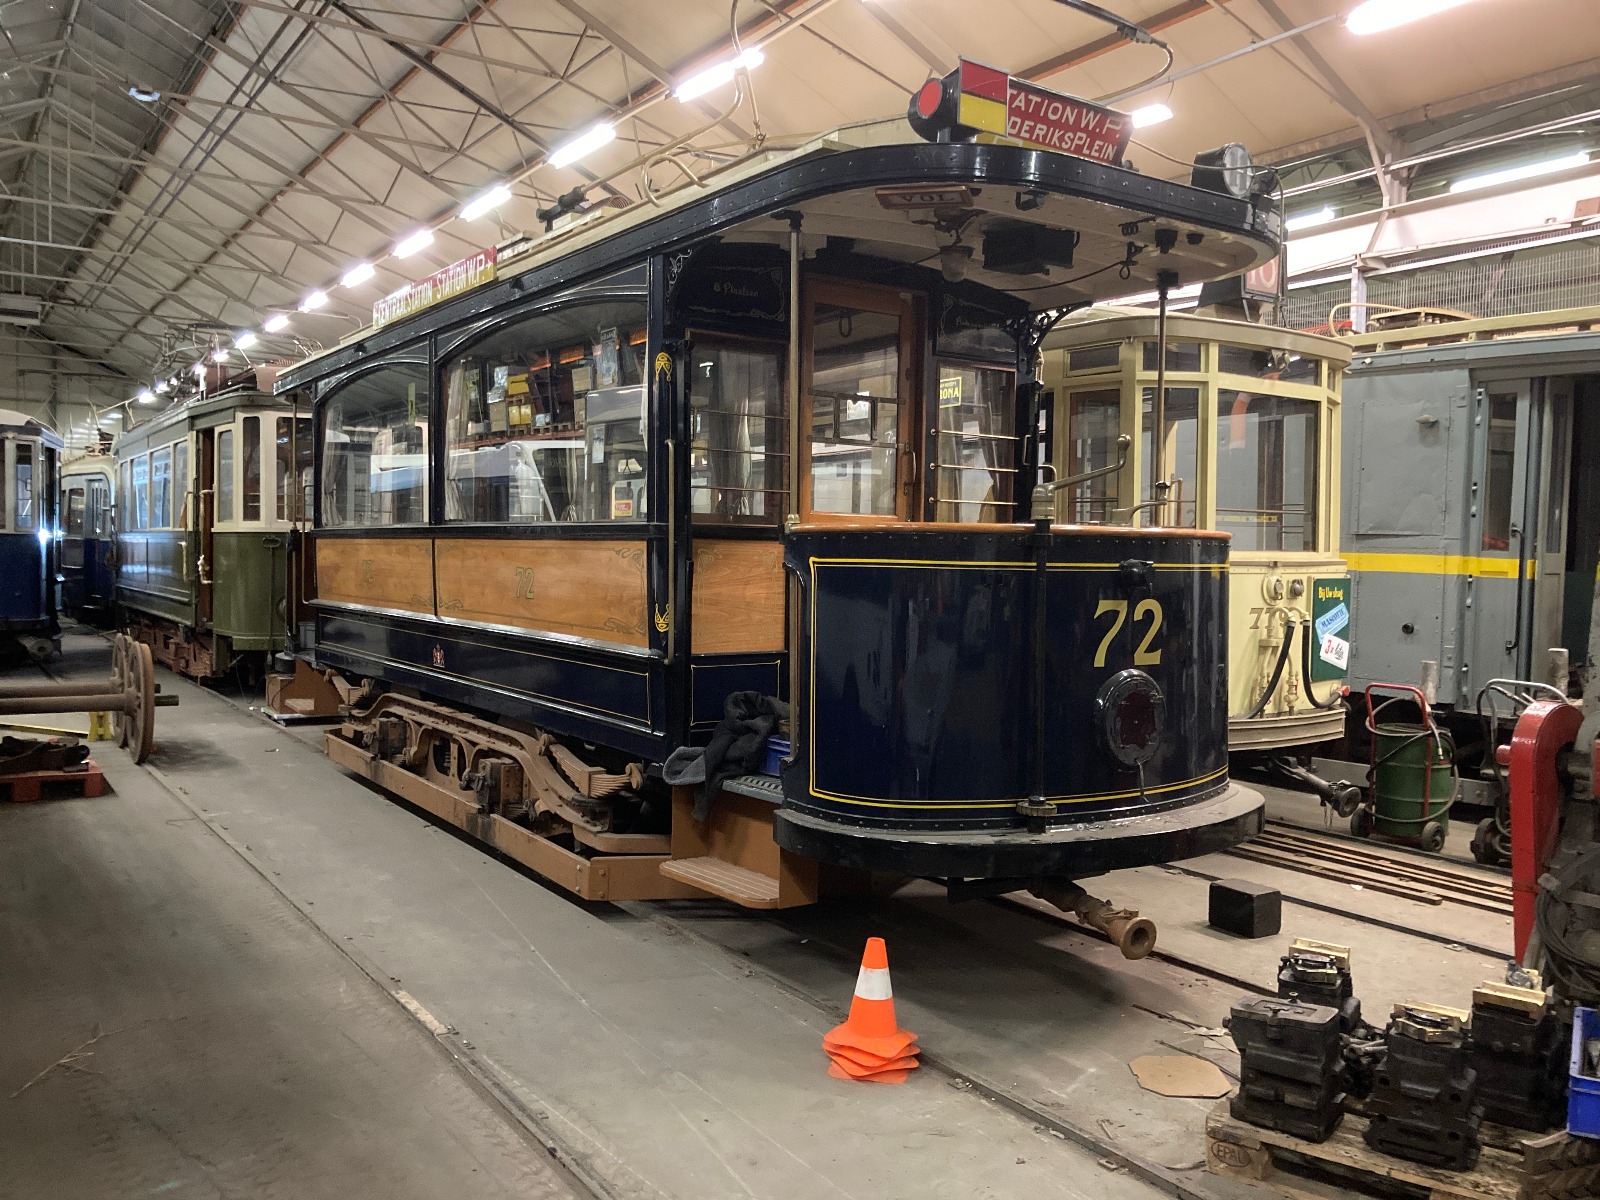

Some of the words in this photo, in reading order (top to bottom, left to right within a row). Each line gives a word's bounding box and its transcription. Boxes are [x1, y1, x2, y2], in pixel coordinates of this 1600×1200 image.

[436, 264, 466, 299] STATION
[466, 254, 485, 286] W.P.
[514, 567, 535, 599] 72
[1093, 598, 1163, 667] 72
